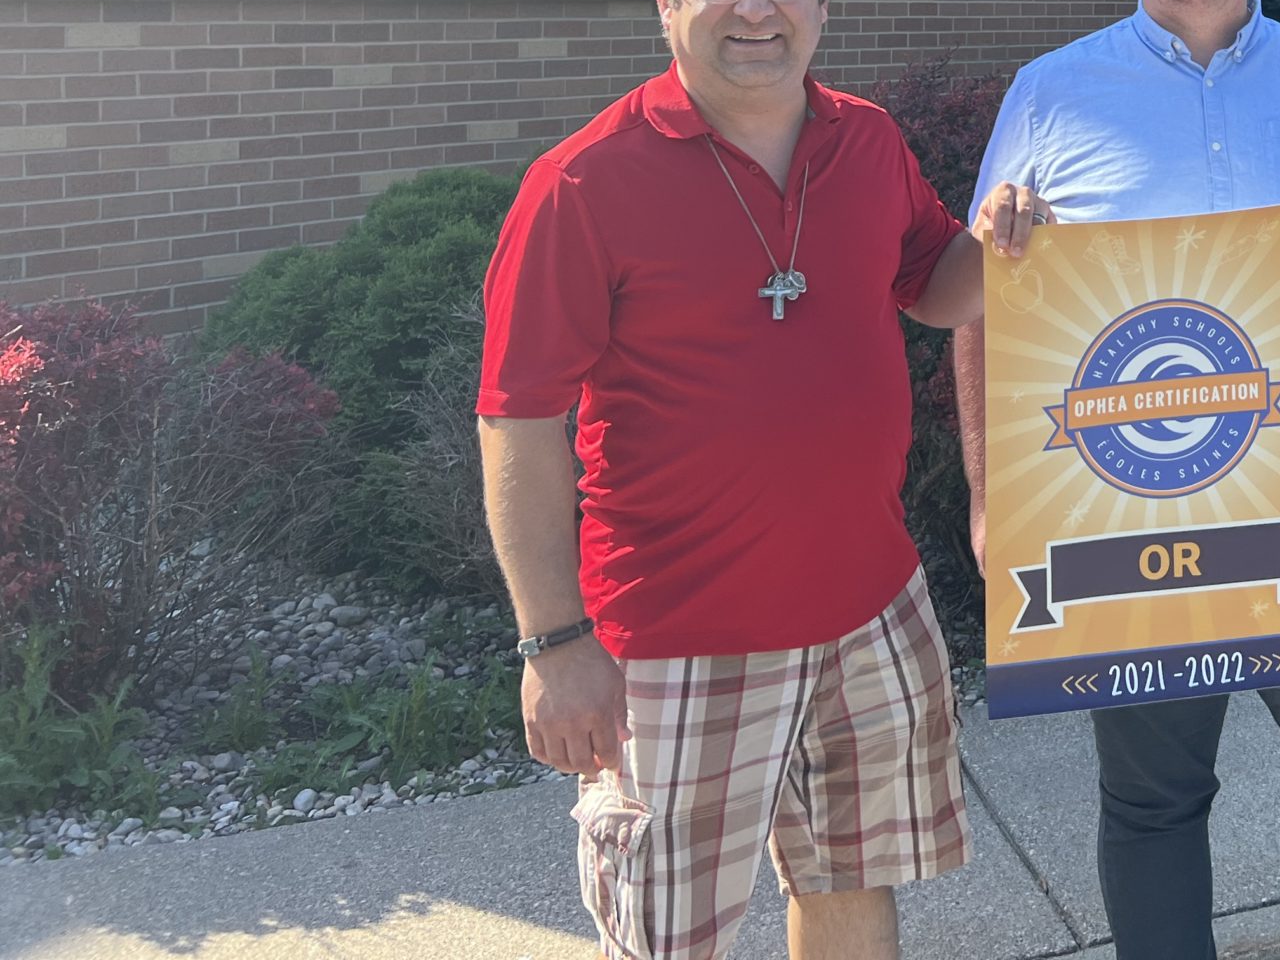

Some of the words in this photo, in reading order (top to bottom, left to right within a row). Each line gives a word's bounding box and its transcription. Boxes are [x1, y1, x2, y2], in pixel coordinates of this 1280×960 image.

[1092, 319, 1157, 379] HEALTHY
[1173, 316, 1240, 365] SCHOOLS
[1074, 395, 1127, 417] OPHEA
[1134, 382, 1260, 410] CERTIFICATION
[1179, 428, 1239, 478] SAINES
[1139, 542, 1202, 580] OR
